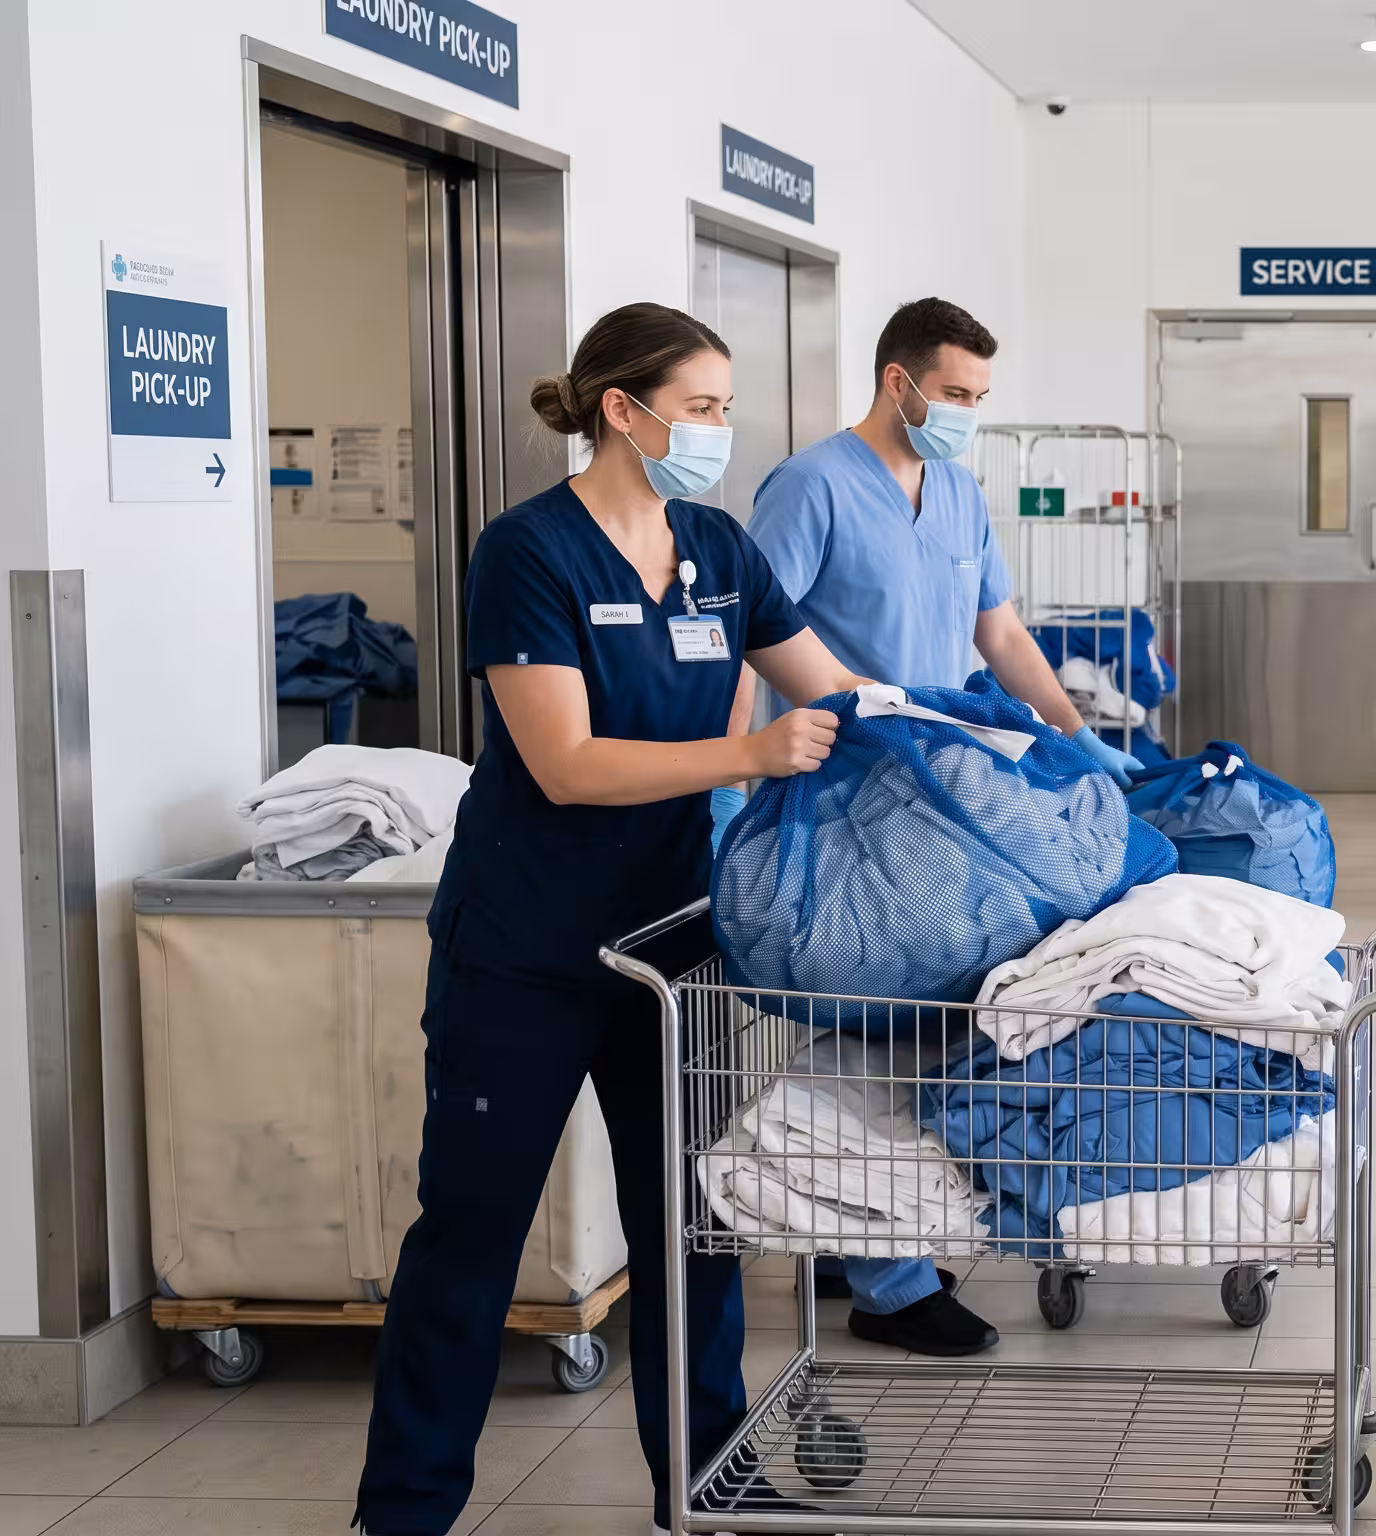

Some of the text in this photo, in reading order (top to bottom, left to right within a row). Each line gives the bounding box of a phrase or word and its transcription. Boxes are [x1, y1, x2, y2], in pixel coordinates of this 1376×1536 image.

[439, 16, 511, 78] PICK-UP
[726, 145, 812, 205] LAUNDRY PICK-UP
[1252, 259, 1370, 285] SERVICE
[122, 325, 216, 365] LAUNDRY
[131, 370, 211, 407] PICK-UP
[601, 610, 623, 618] SARAH
